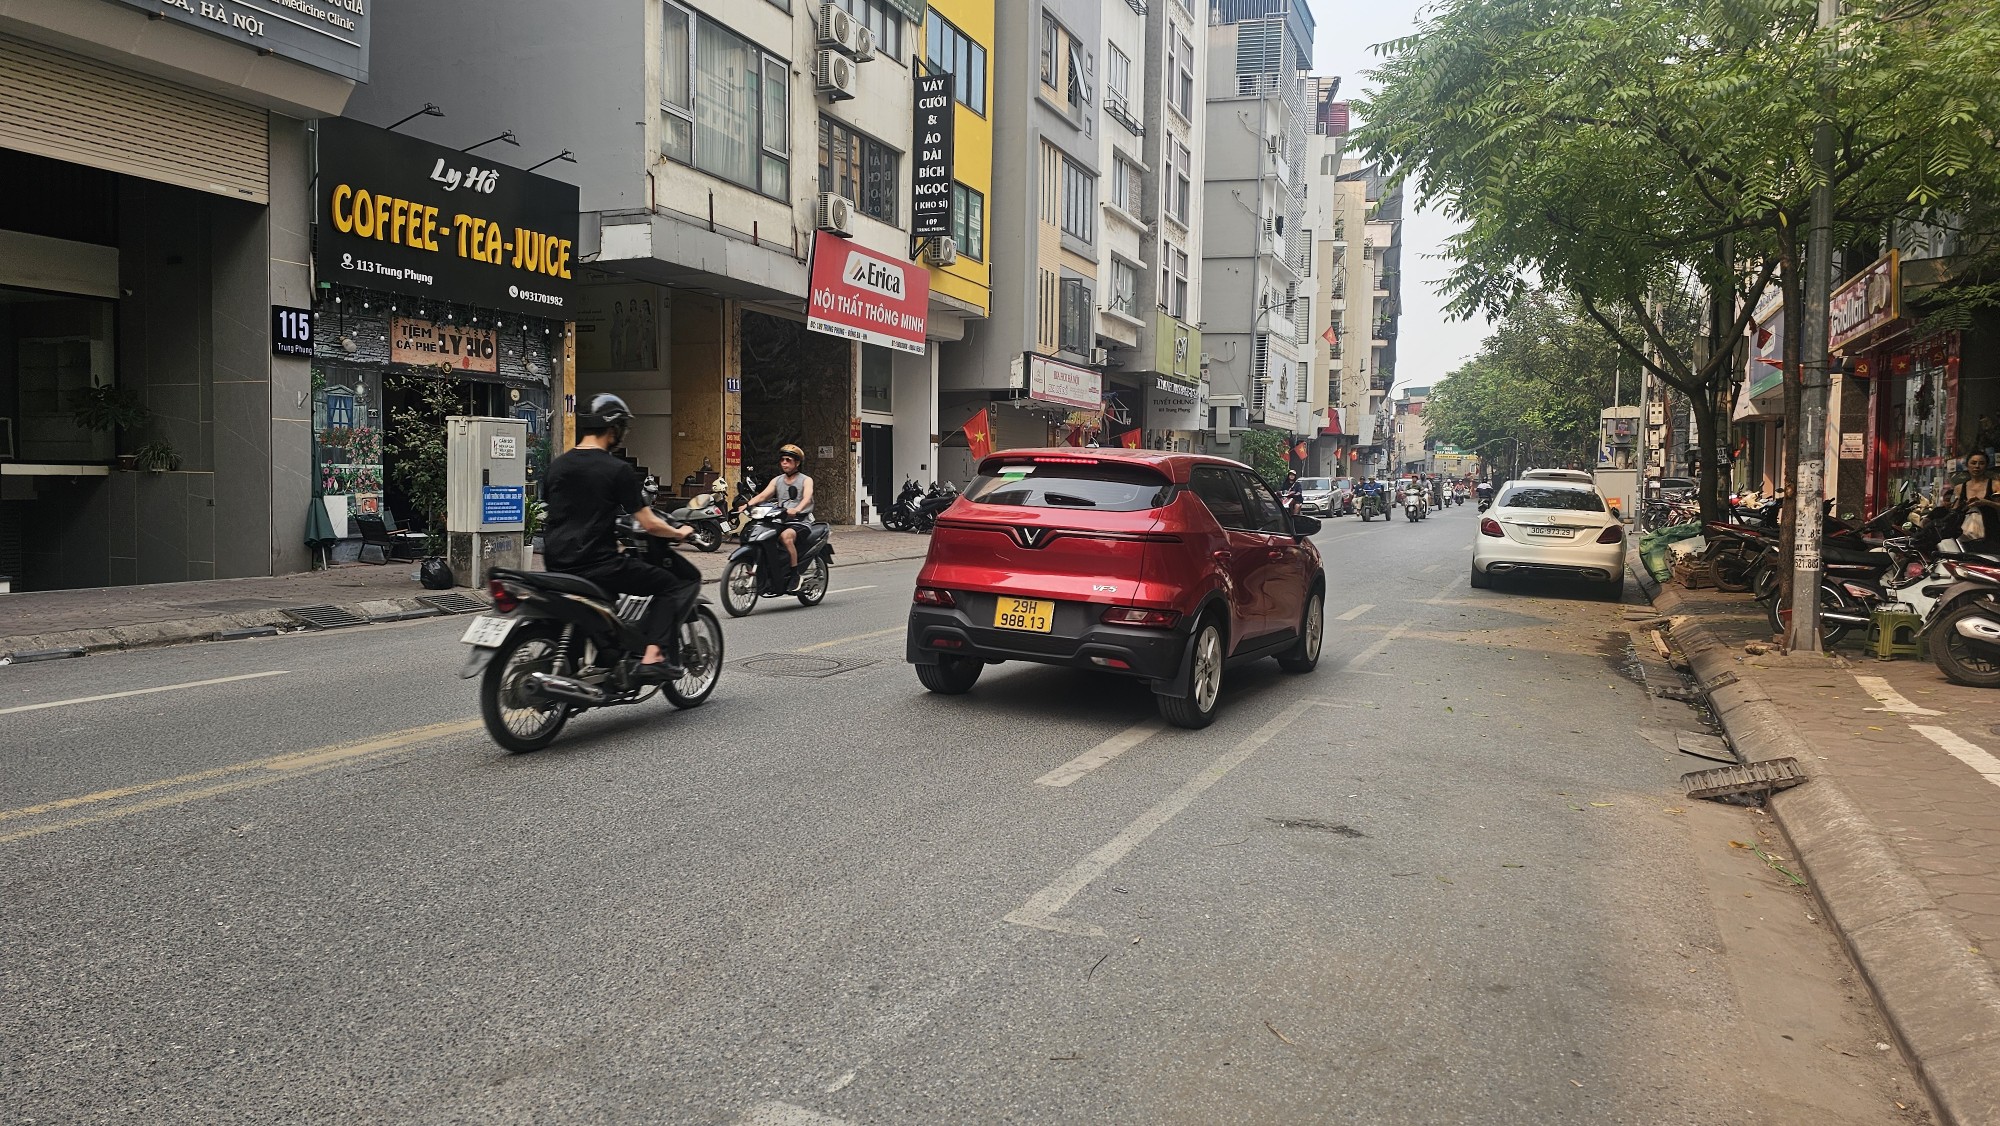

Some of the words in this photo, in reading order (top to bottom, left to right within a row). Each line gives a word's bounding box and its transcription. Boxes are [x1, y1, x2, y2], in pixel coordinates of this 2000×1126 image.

[200, 1, 229, 24] HÀ
[232, 12, 264, 37] NỘI
[281, 0, 326, 20] Medicine
[326, 12, 355, 31] Clinic
[922, 79, 944, 92] VÁY
[918, 95, 947, 109] CƯỚI
[927, 114, 938, 125] &
[924, 131, 941, 145] ÁO
[922, 147, 942, 161] DÀI
[429, 158, 462, 191] Ly
[463, 166, 500, 194] Hồ
[919, 165, 945, 178] BÍCH
[915, 182, 949, 196] NGỌC
[356, 259, 374, 273] 113
[375, 263, 403, 280] Trung
[404, 267, 433, 286] Phụng
[867, 262, 900, 294] Erica
[519, 289, 564, 307] 0931701982
[813, 287, 835, 314] NỘI
[837, 293, 864, 317] THẤT
[865, 303, 899, 327] THÔNG
[900, 313, 924, 333] MINH
[279, 310, 310, 341] 115
[277, 342, 295, 354] Trung
[438, 333, 464, 356] LY
[728, 378, 740, 390] 111
[1012, 599, 1037, 615] 29H
[1000, 614, 1045, 630] 988.13
